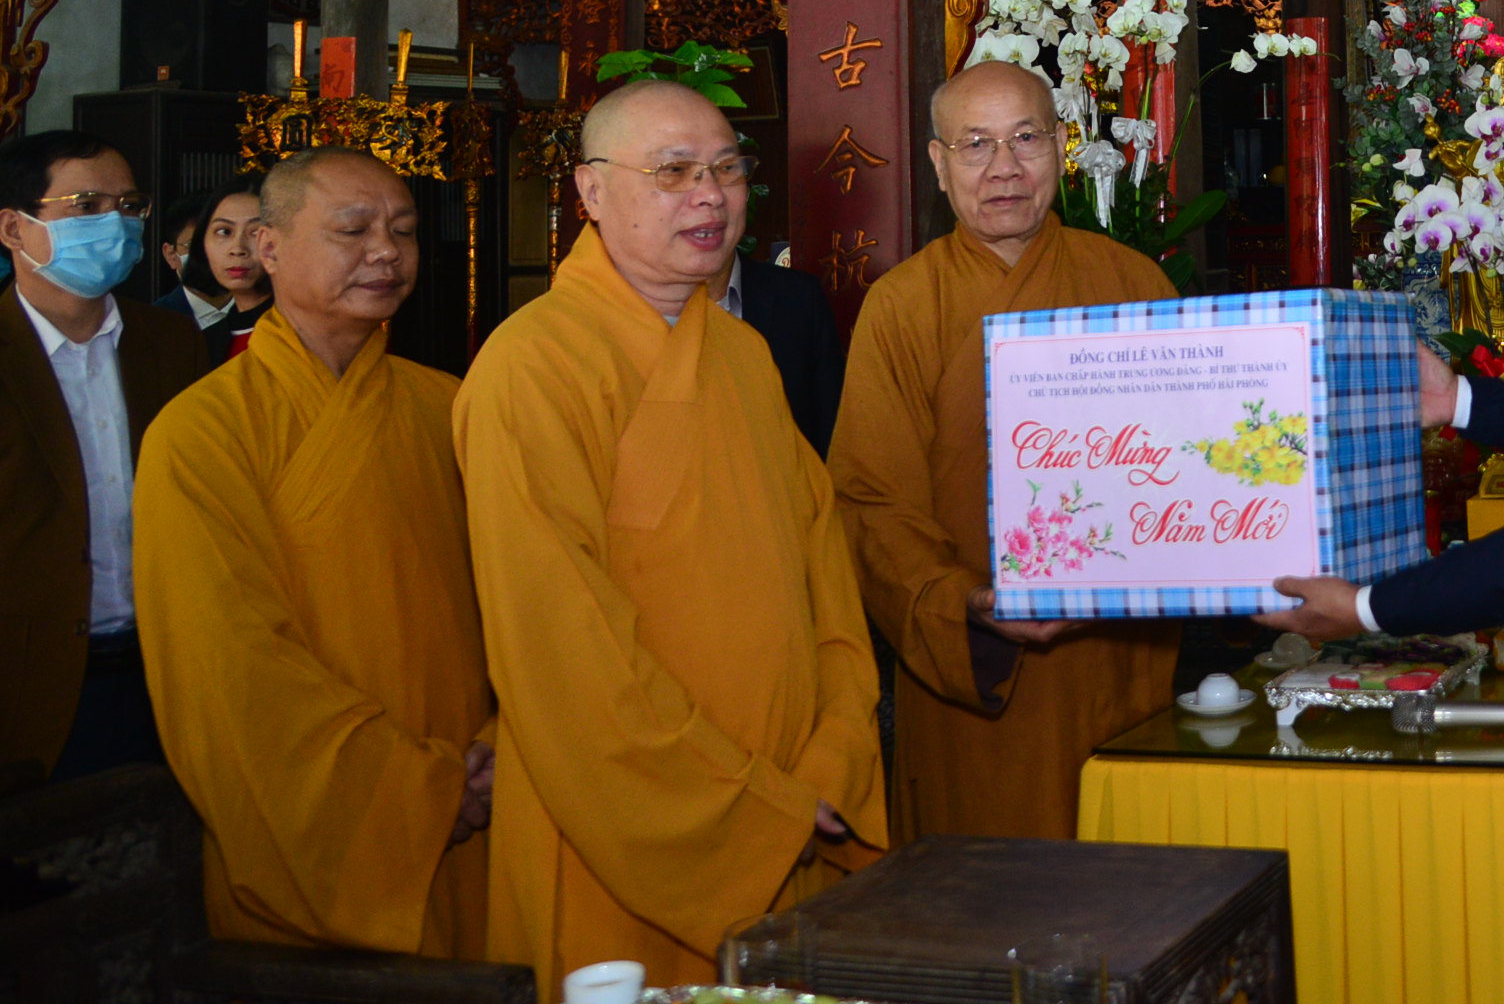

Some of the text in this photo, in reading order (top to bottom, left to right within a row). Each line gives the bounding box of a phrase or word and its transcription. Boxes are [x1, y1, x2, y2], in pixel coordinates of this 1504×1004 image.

[1070, 347, 1105, 365] ĐỒNG
[1108, 347, 1130, 363] CHÍ
[1133, 346, 1150, 362] LÊ
[1180, 343, 1224, 359] THÀNH
[1046, 371, 1063, 382] BAN
[1065, 369, 1090, 381] CHẤP
[1091, 369, 1116, 380] HÀNH
[1118, 368, 1148, 379] TRUNG
[1242, 361, 1273, 373] THÀNH
[1049, 387, 1070, 398] TỊCH
[1090, 382, 1115, 395] ĐỒNG
[1117, 382, 1142, 394] NHÂN
[1143, 381, 1162, 393] DÂN
[1164, 379, 1195, 392] THÀNH
[1197, 377, 1216, 390] PHỐ
[1011, 420, 1181, 486] Chúc Mừng
[1130, 496, 1290, 546] Năm Mới
